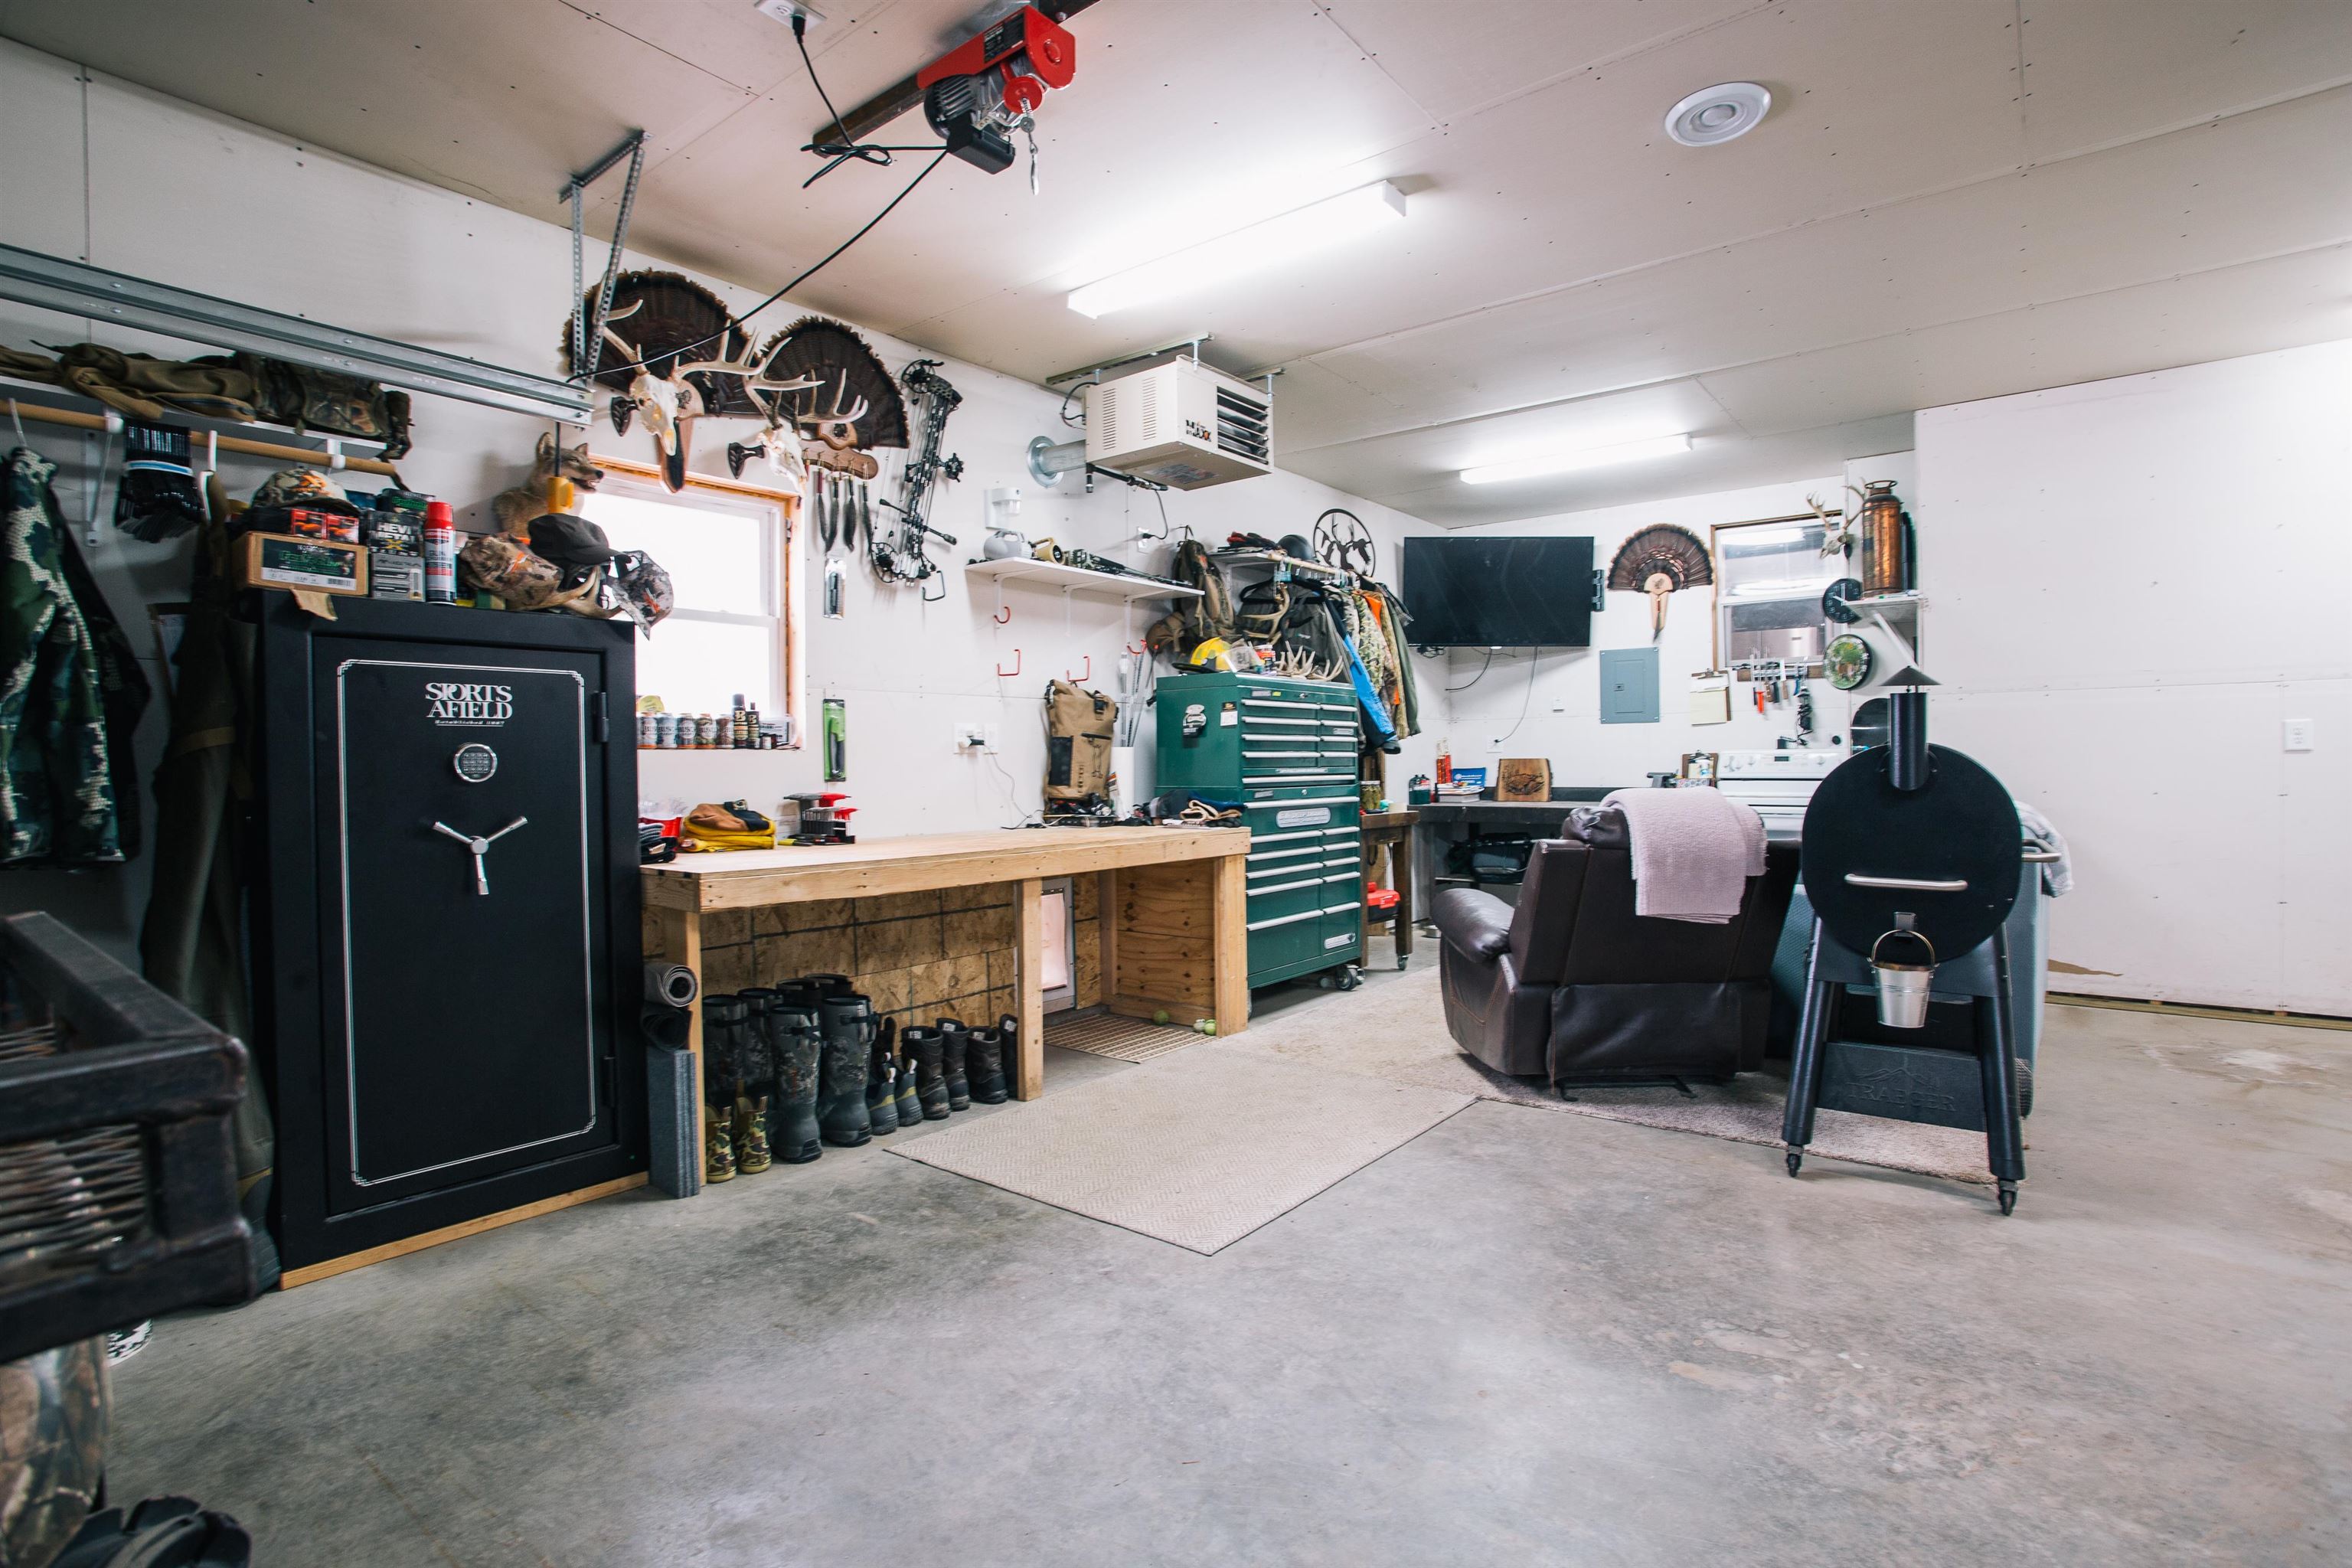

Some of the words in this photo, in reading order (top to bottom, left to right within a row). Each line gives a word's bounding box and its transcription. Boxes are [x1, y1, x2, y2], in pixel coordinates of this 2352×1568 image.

[425, 682, 513, 702] SPORTS
[426, 700, 513, 719] AFIELD
[1846, 1082, 1957, 1111] TRAEGER
